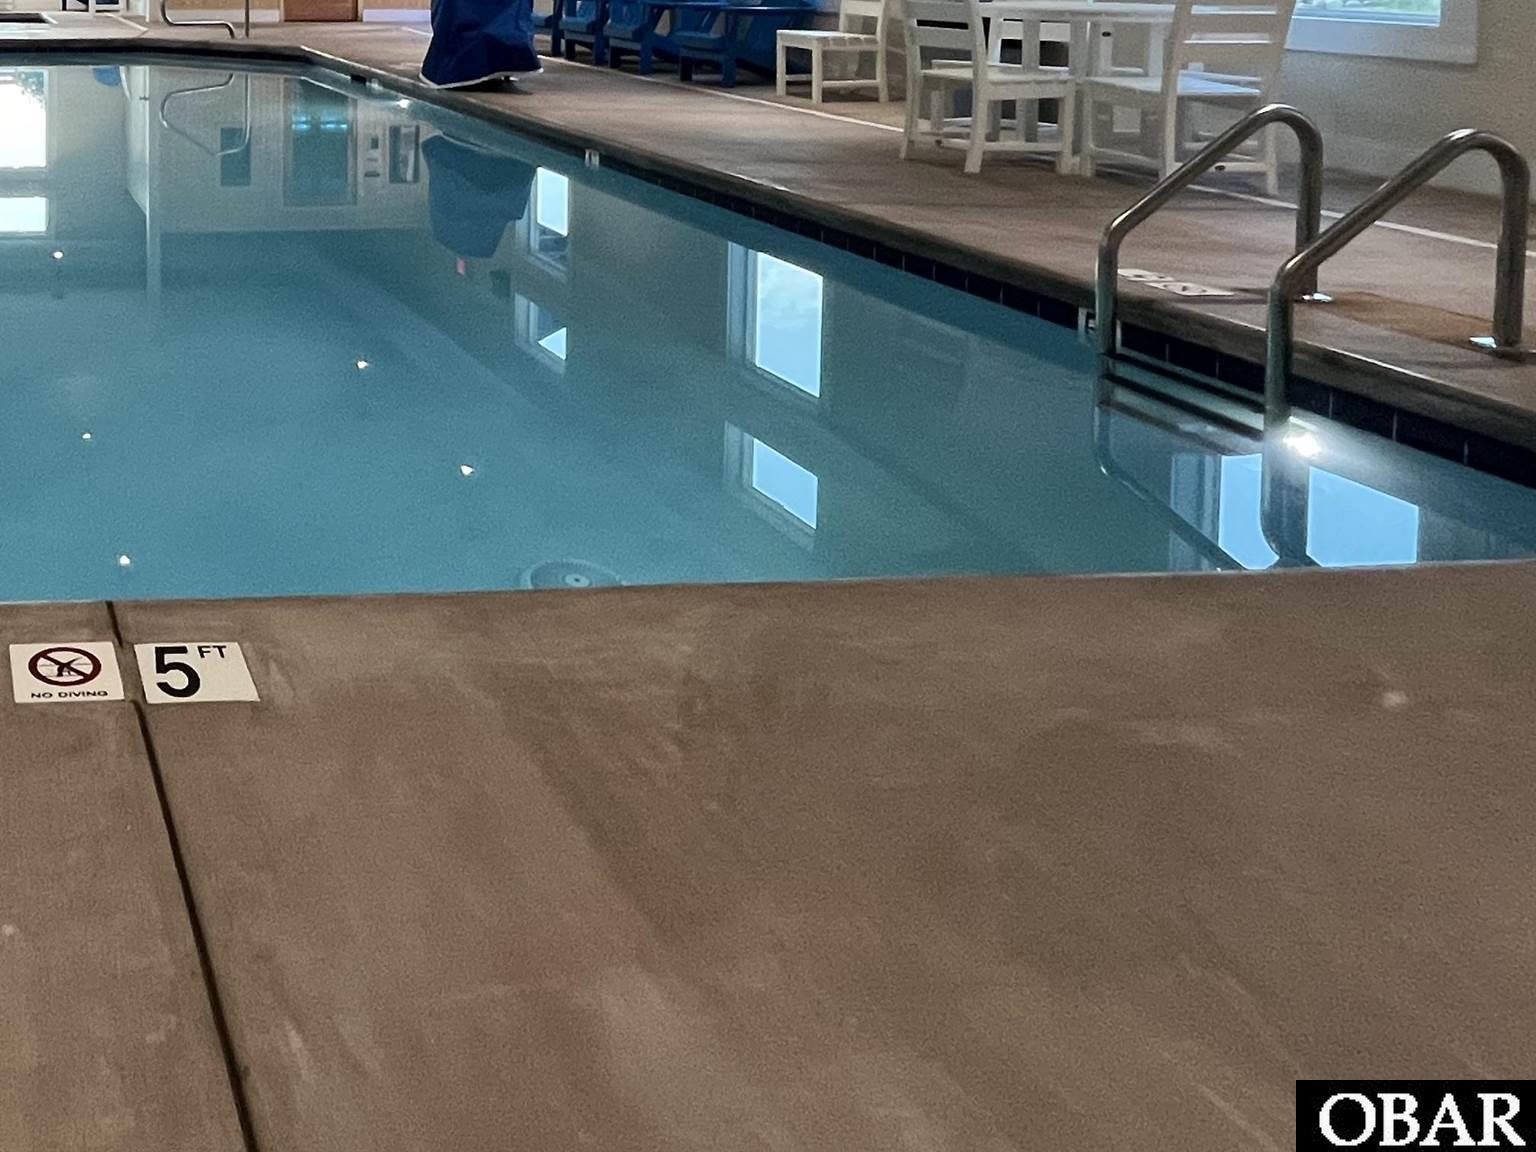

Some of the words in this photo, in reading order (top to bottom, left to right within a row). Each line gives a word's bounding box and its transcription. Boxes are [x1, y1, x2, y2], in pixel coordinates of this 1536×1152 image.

[155, 646, 201, 698] 5
[197, 645, 227, 659] FT
[58, 690, 108, 698] DIVING
